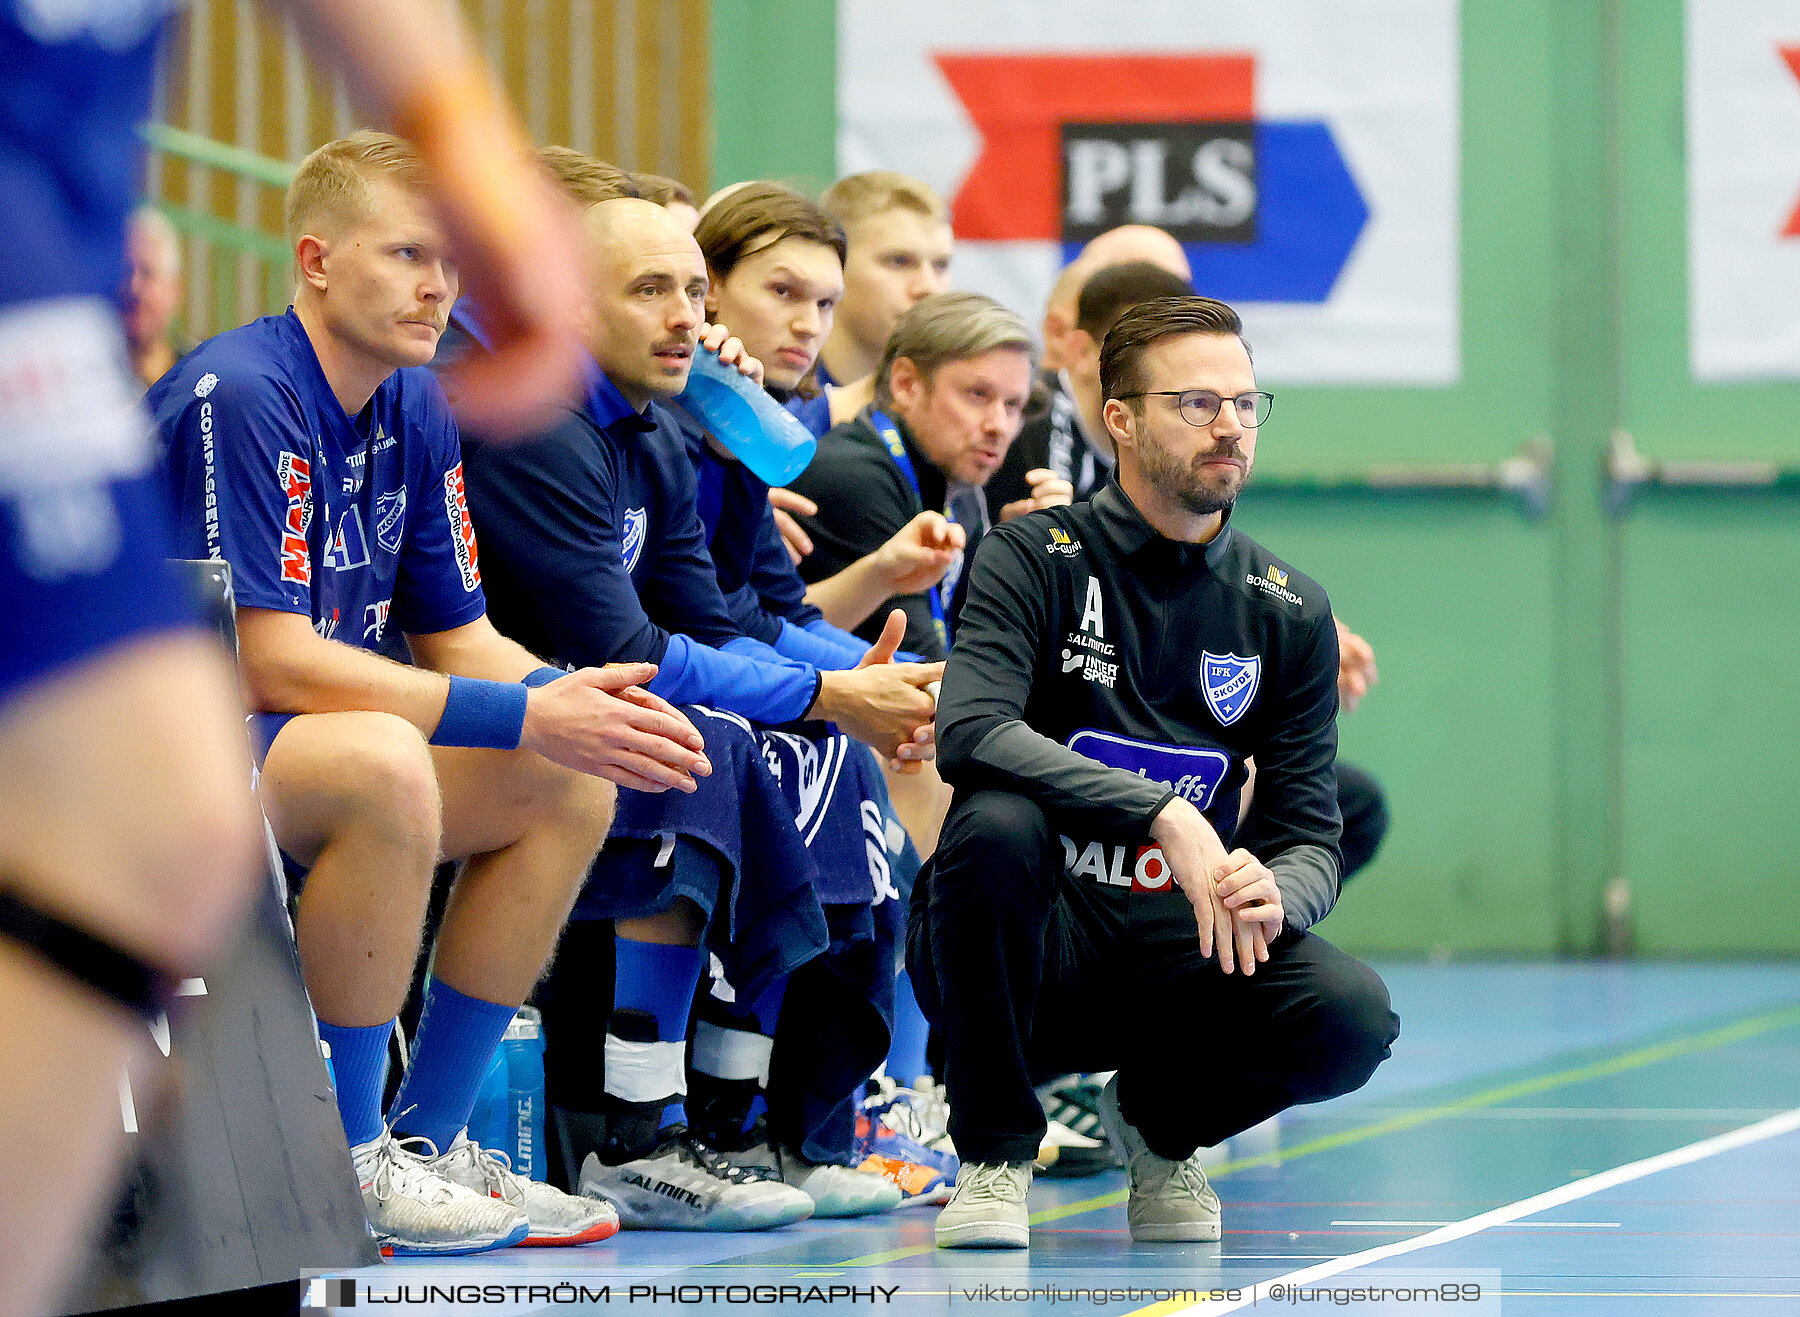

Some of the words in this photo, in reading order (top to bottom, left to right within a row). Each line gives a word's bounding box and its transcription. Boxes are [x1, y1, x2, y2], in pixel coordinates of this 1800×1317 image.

[1067, 138, 1257, 226] PLS
[1246, 573, 1304, 606] BORGUNDA
[1079, 575, 1104, 638] A
[1083, 668, 1117, 689] SPORT
[1085, 654, 1118, 677] INTER
[1211, 666, 1233, 678] IFK
[1213, 670, 1252, 699] SKÖVDE
